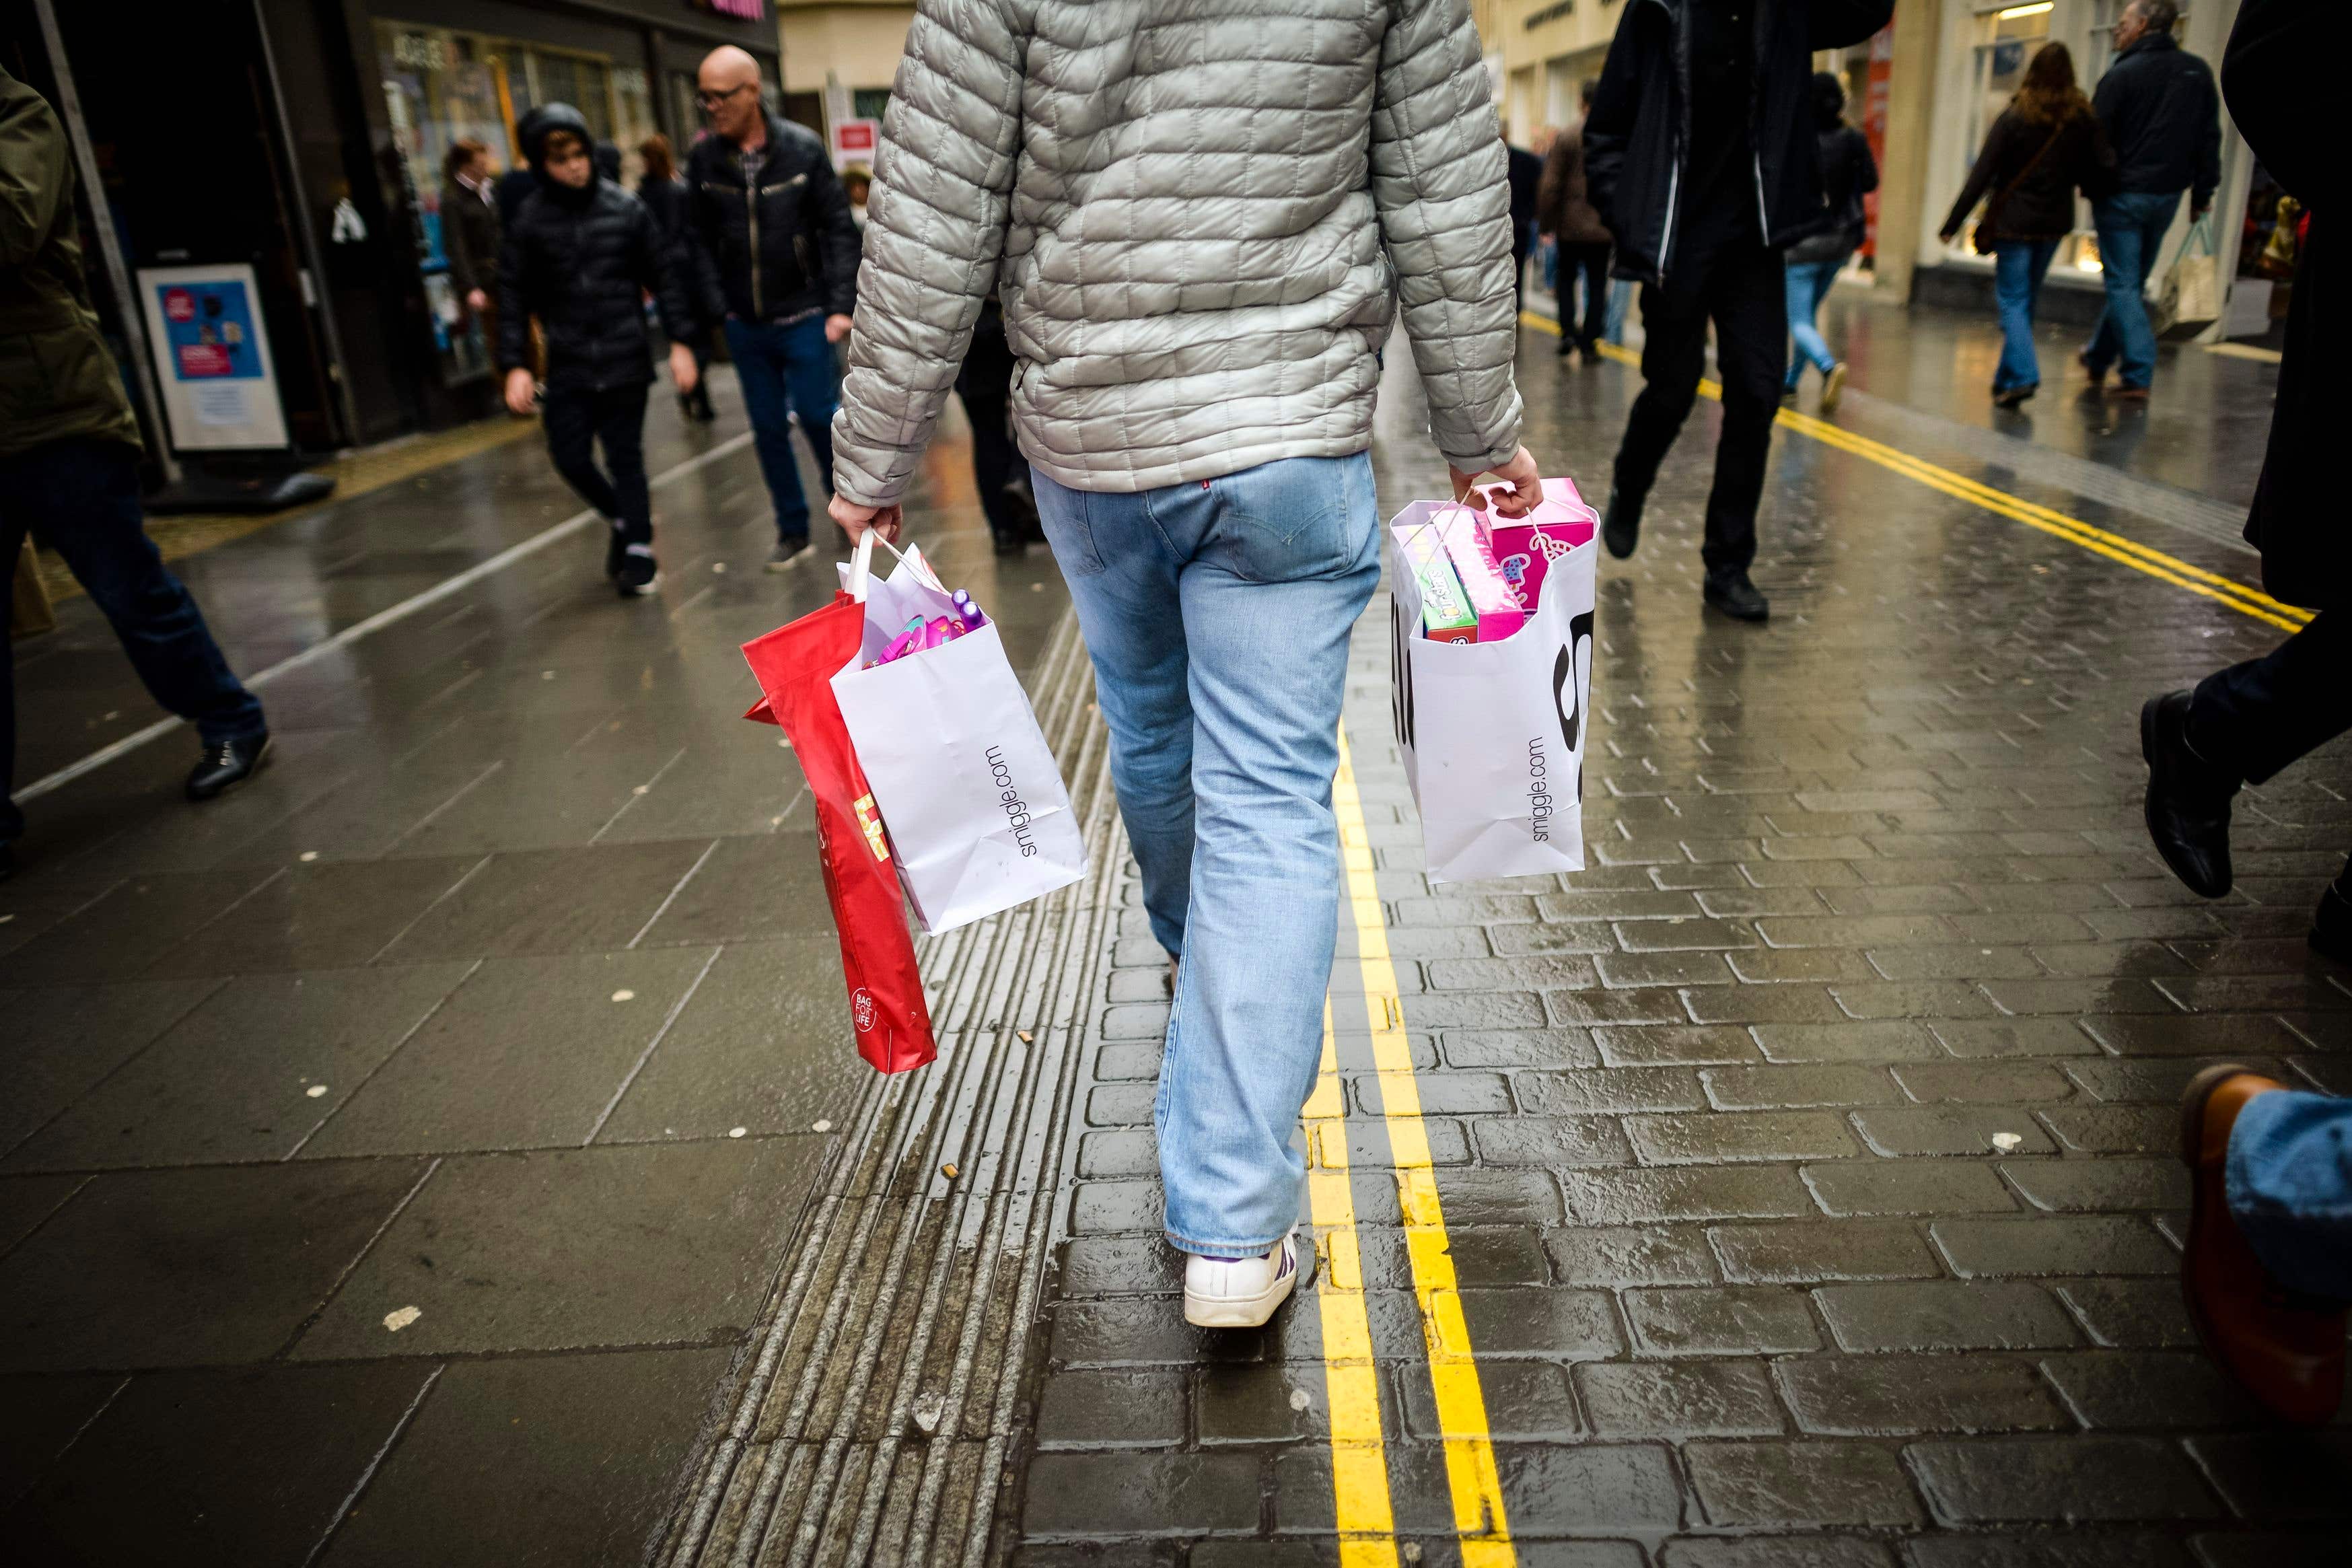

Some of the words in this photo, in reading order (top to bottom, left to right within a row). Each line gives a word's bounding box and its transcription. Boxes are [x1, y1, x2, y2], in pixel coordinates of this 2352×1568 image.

[1526, 736, 1553, 842] smiggle.com
[985, 745, 1037, 857] smiggle.com
[857, 993, 871, 1007] BAG
[855, 1003, 872, 1017] FOR
[855, 1012, 870, 1027] LIFE
